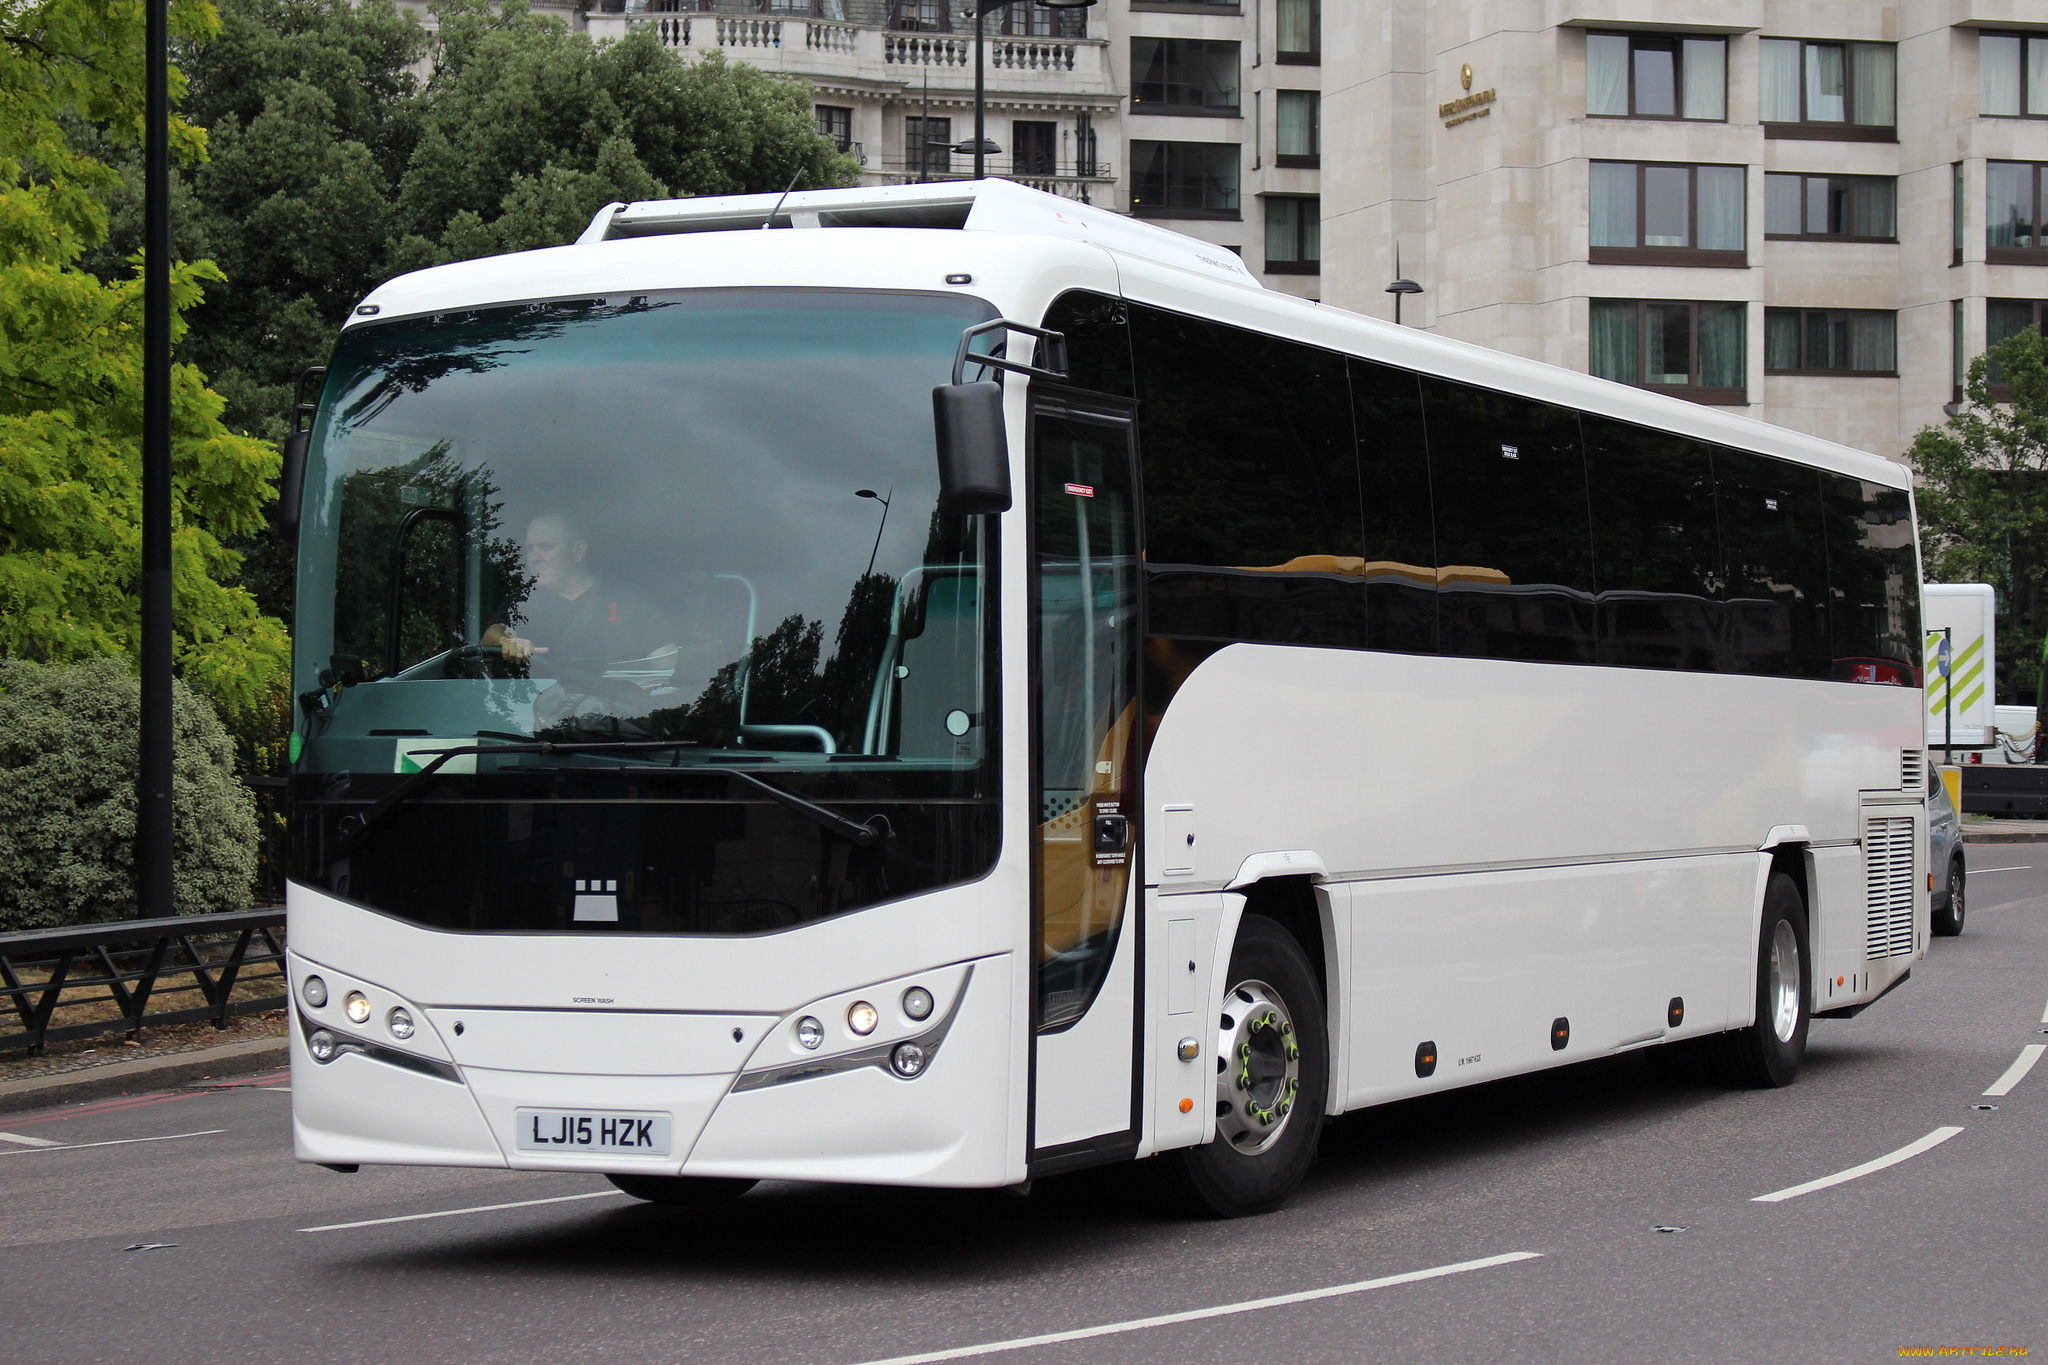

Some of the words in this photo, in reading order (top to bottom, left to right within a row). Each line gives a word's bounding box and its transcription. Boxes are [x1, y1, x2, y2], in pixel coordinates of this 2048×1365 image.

[572, 996, 596, 1004] SCREEN
[533, 1115, 592, 1145] LJ15
[601, 1117, 653, 1147] HZK
